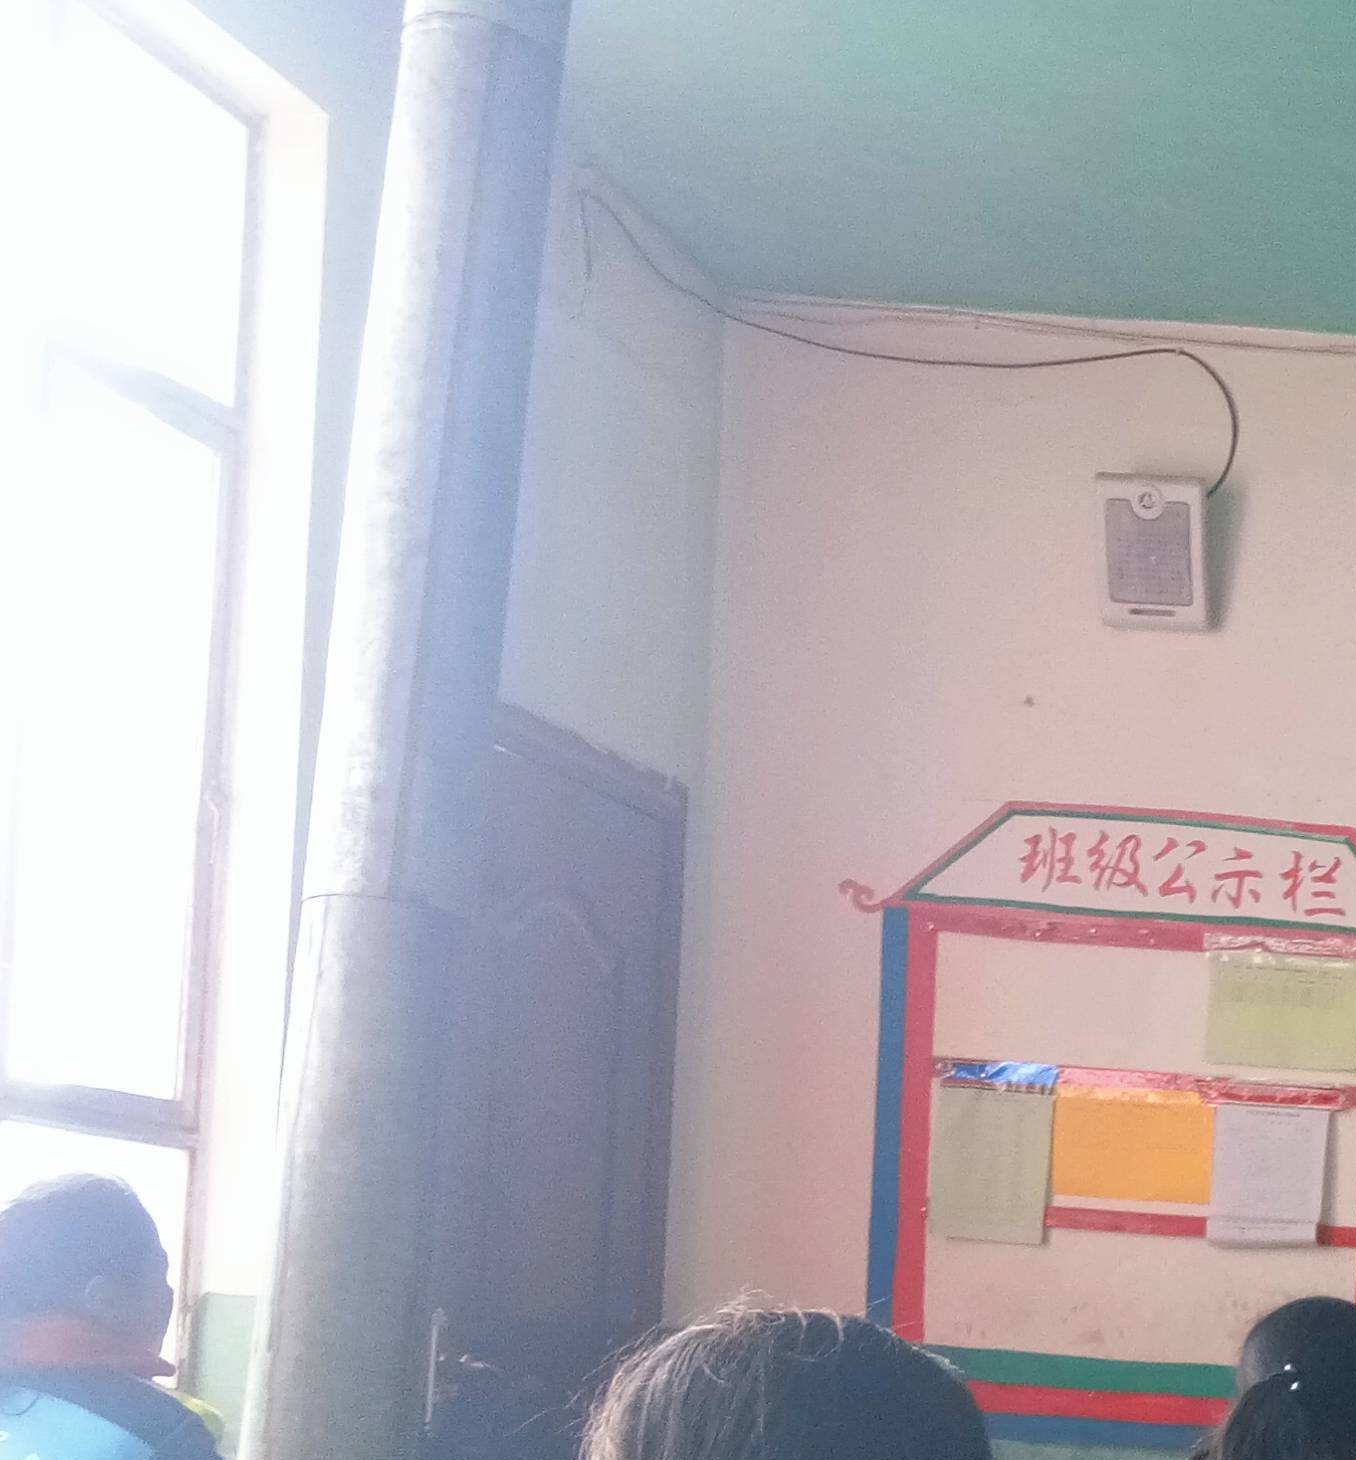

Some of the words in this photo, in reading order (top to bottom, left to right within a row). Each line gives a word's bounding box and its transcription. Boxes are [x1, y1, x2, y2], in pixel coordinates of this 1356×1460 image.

[1018, 825, 1347, 918] 班级公示栏
